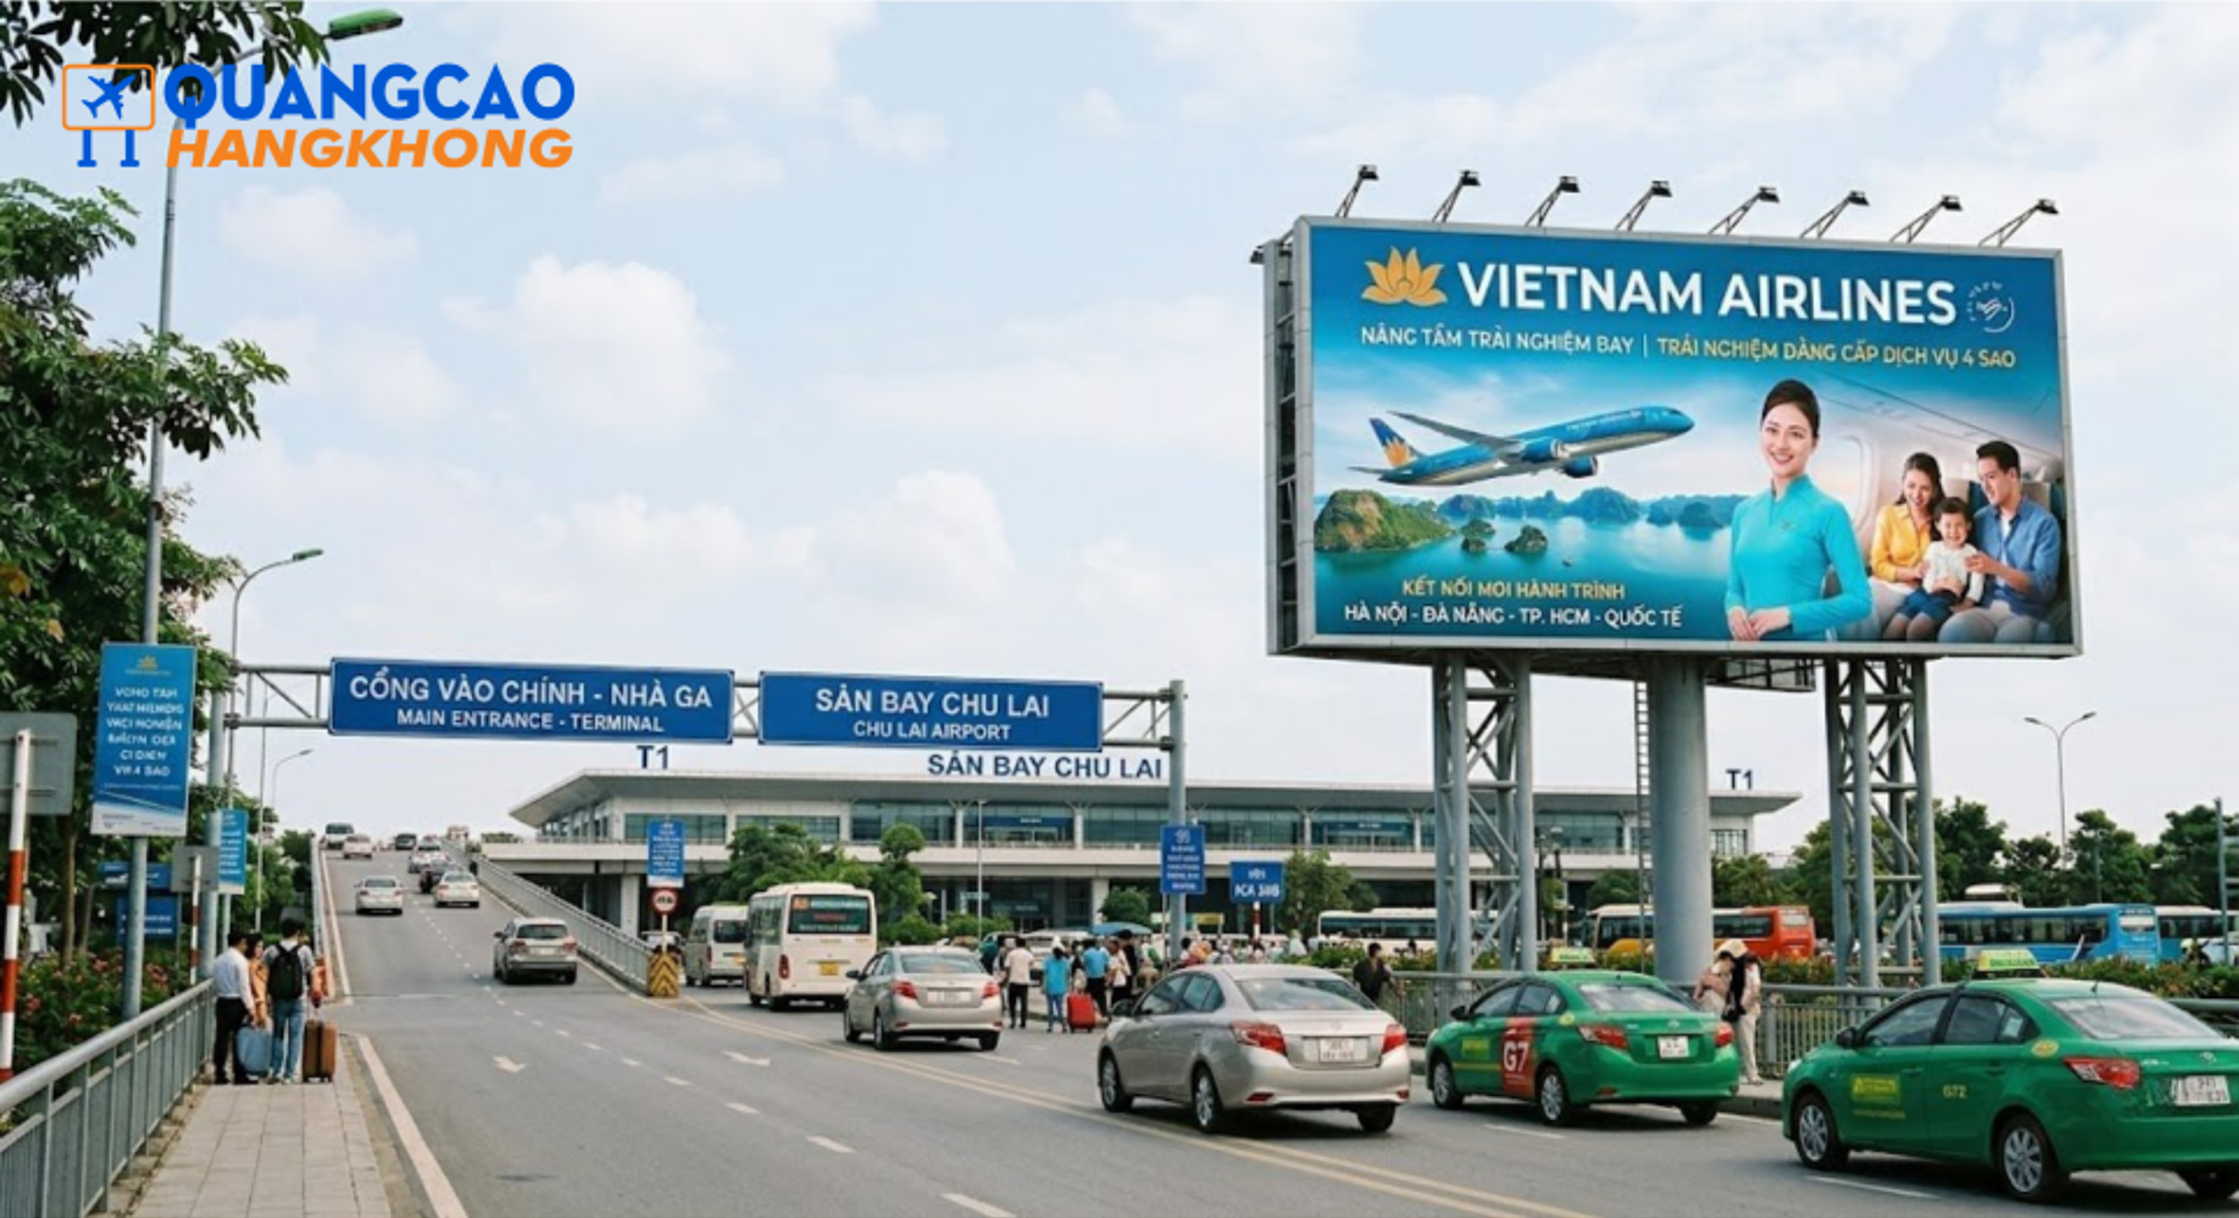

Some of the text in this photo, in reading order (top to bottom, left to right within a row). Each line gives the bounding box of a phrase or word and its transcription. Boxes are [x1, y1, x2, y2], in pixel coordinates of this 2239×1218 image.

[1457, 261, 1703, 315] VIETNAM
[1717, 272, 1957, 326] AIRLINES
[1597, 335, 1634, 354] BAY
[1962, 349, 1974, 367] 4
[1978, 349, 2016, 368] SAO
[1516, 578, 1568, 598] HÀNH
[1344, 601, 1371, 621] HÀ
[1375, 601, 1407, 627] NỘI
[1519, 608, 1545, 625] TP.
[1550, 608, 1591, 625] HCM
[1604, 604, 1656, 629] QUỐC
[437, 673, 495, 703] VÀO
[501, 676, 585, 704] CHÍNH
[611, 678, 667, 708] NHÀ
[675, 685, 713, 708] GA
[881, 691, 935, 714] BAY
[941, 693, 998, 717] CHU
[1008, 695, 1049, 718] LAI
[397, 708, 445, 726] MAIN
[452, 710, 553, 730] ENTRANCE
[570, 713, 665, 732] TERMINAL
[853, 720, 1012, 741] CHU LAI AIRPORT
[636, 745, 669, 770] T1
[994, 755, 1046, 777] BAY
[1055, 756, 1110, 779] CHU
[1121, 758, 1162, 780] LAI
[1725, 768, 1752, 790] T1
[1503, 1040, 1530, 1073] G7
